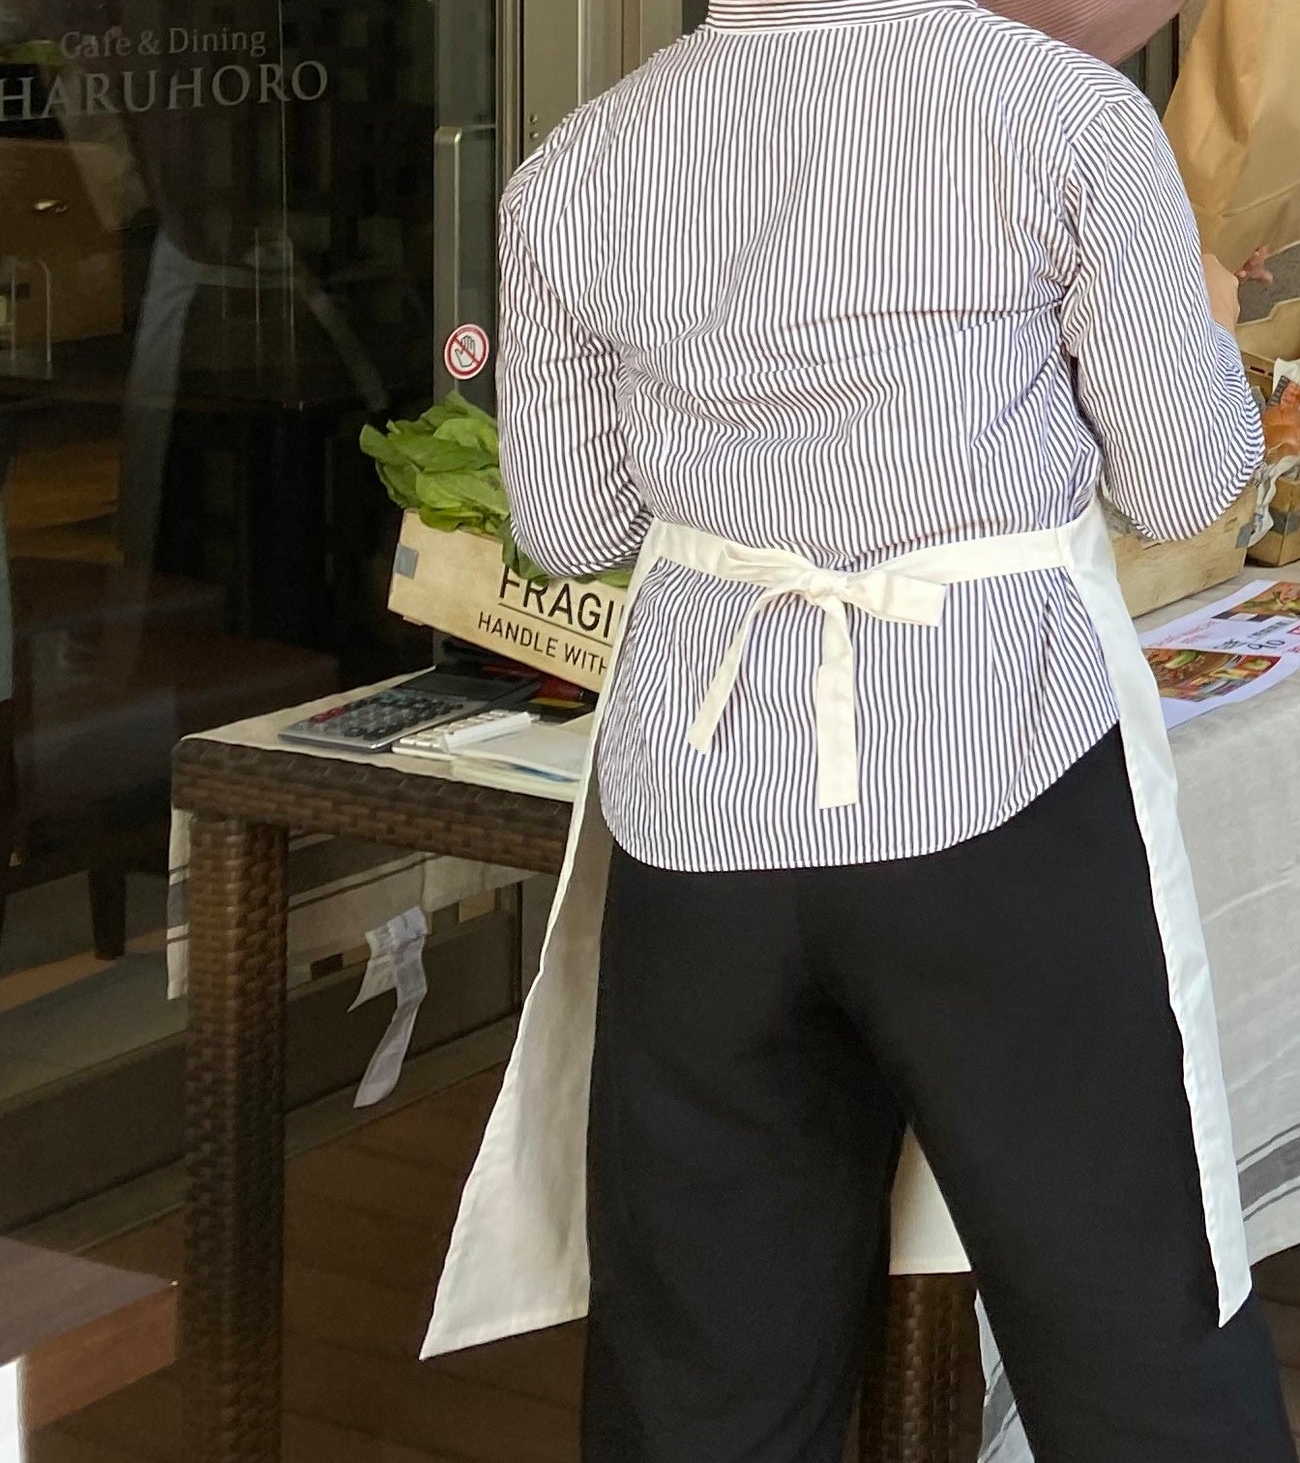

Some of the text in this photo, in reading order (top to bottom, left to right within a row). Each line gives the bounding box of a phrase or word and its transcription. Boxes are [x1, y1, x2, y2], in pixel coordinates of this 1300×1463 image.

[138, 29, 162, 56] &
[168, 26, 267, 58] Dining
[0, 59, 329, 123] HARUHORO
[500, 564, 624, 638] FRAGI
[478, 611, 559, 658] HANDLE
